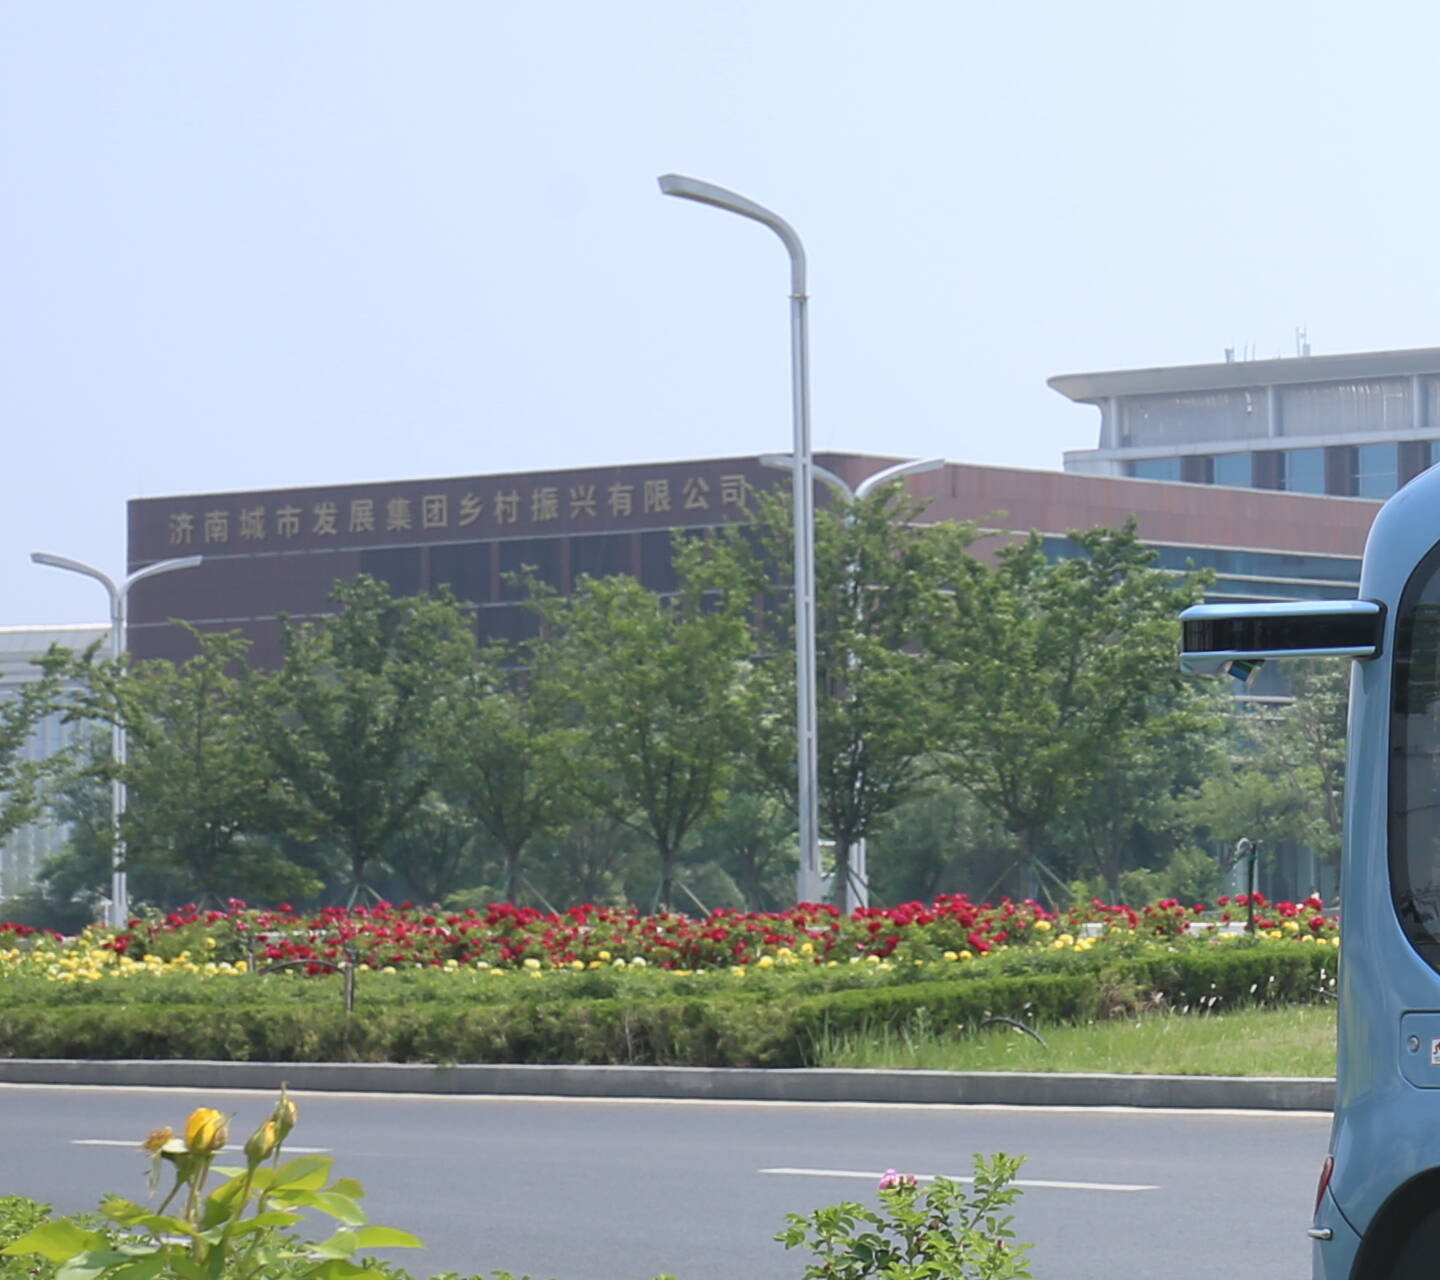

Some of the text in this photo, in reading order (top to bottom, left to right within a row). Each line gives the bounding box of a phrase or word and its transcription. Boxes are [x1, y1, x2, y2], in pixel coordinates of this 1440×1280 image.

[168, 473, 749, 546] 济南城市发展集团乡村振兴有限公司
